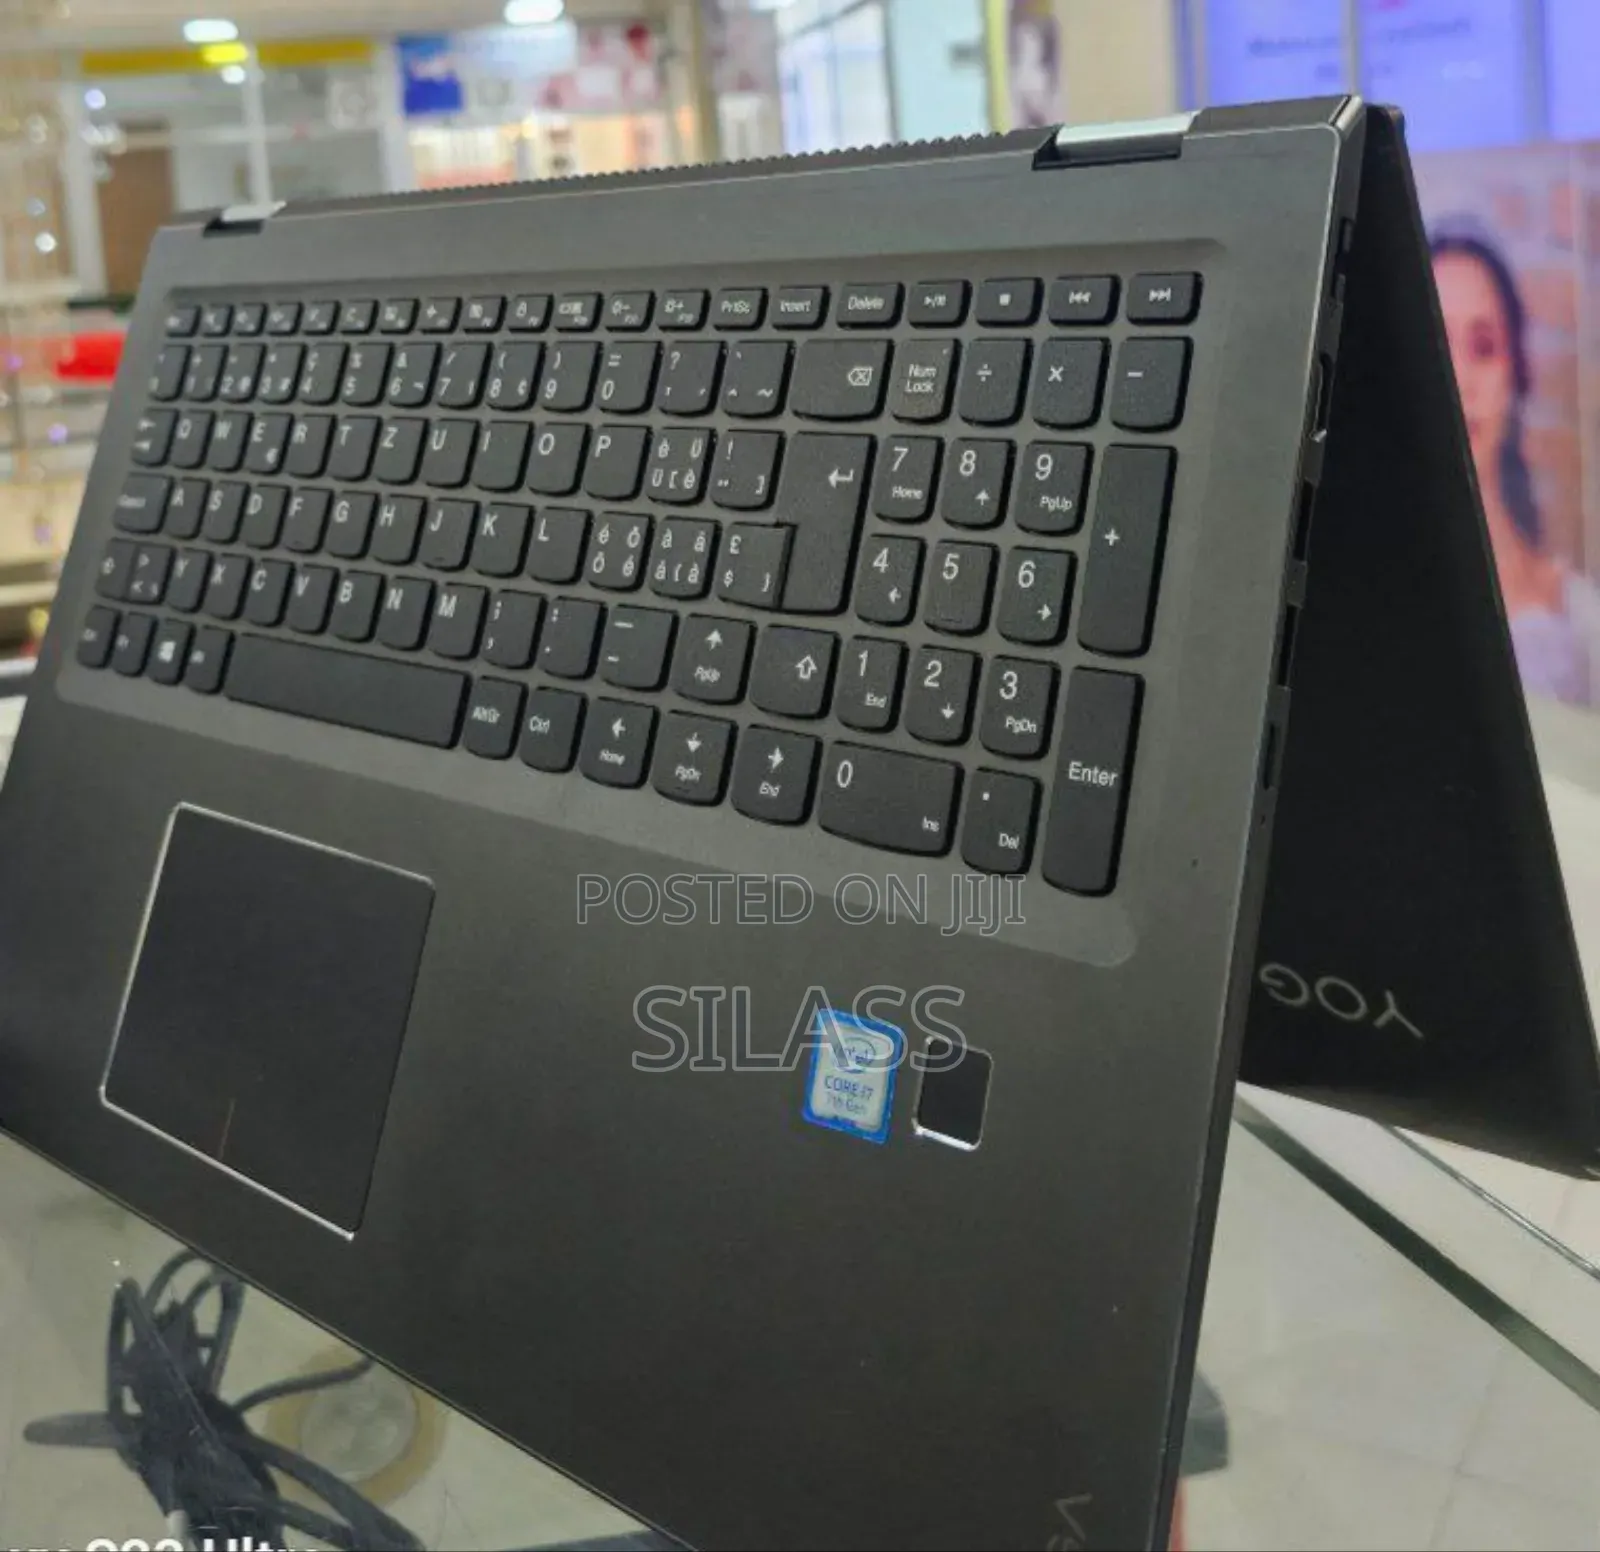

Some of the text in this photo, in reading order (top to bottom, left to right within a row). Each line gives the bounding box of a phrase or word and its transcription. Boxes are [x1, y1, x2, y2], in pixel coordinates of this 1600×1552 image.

[848, 296, 884, 310] Delete
[671, 351, 681, 370] ?
[909, 364, 936, 377] Num
[390, 377, 402, 396] 6
[439, 377, 451, 396] 7
[490, 378, 501, 398] 8
[545, 379, 557, 399] 9
[602, 380, 614, 400] 0
[905, 380, 933, 392] Lock
[215, 421, 231, 439] W
[252, 421, 266, 442] E
[293, 423, 307, 443] R
[340, 425, 352, 445] T
[382, 427, 398, 448] Z
[431, 430, 447, 450] U
[482, 431, 491, 451] I
[538, 433, 554, 455] O
[595, 435, 611, 457] P
[727, 440, 733, 459] !
[892, 447, 908, 471] 7
[960, 450, 976, 476] 8
[1035, 454, 1053, 480] 9
[171, 488, 184, 506] A
[209, 490, 223, 511] S
[892, 486, 922, 499] Home
[247, 493, 262, 515] D
[289, 497, 303, 516] F
[334, 501, 349, 522] G
[1040, 496, 1072, 512] PgUp
[380, 505, 395, 526] H
[430, 510, 443, 531] J
[482, 514, 497, 536] K
[538, 519, 549, 541] L
[730, 535, 741, 554] £
[176, 558, 189, 577] Y
[873, 548, 889, 572] 4
[943, 553, 959, 580] 5
[211, 563, 226, 583] X
[252, 569, 267, 591] C
[724, 570, 733, 587] $
[1018, 560, 1035, 588] 6
[297, 576, 309, 596] V
[339, 580, 353, 603] B
[387, 588, 403, 610] N
[438, 594, 457, 618] M
[859, 650, 868, 676] 1
[924, 660, 941, 687] 2
[1000, 671, 1017, 699] 3
[864, 692, 887, 708] End
[529, 716, 550, 733] Ctrl
[1006, 716, 1037, 733] PgDn
[600, 750, 626, 765] Home
[675, 765, 701, 781] PgDn
[837, 760, 853, 788] 0
[1069, 761, 1117, 787] Enter
[760, 782, 780, 796] End
[922, 817, 940, 832] Ins
[999, 833, 1019, 849] Del
[824, 1074, 858, 1093] CORE
